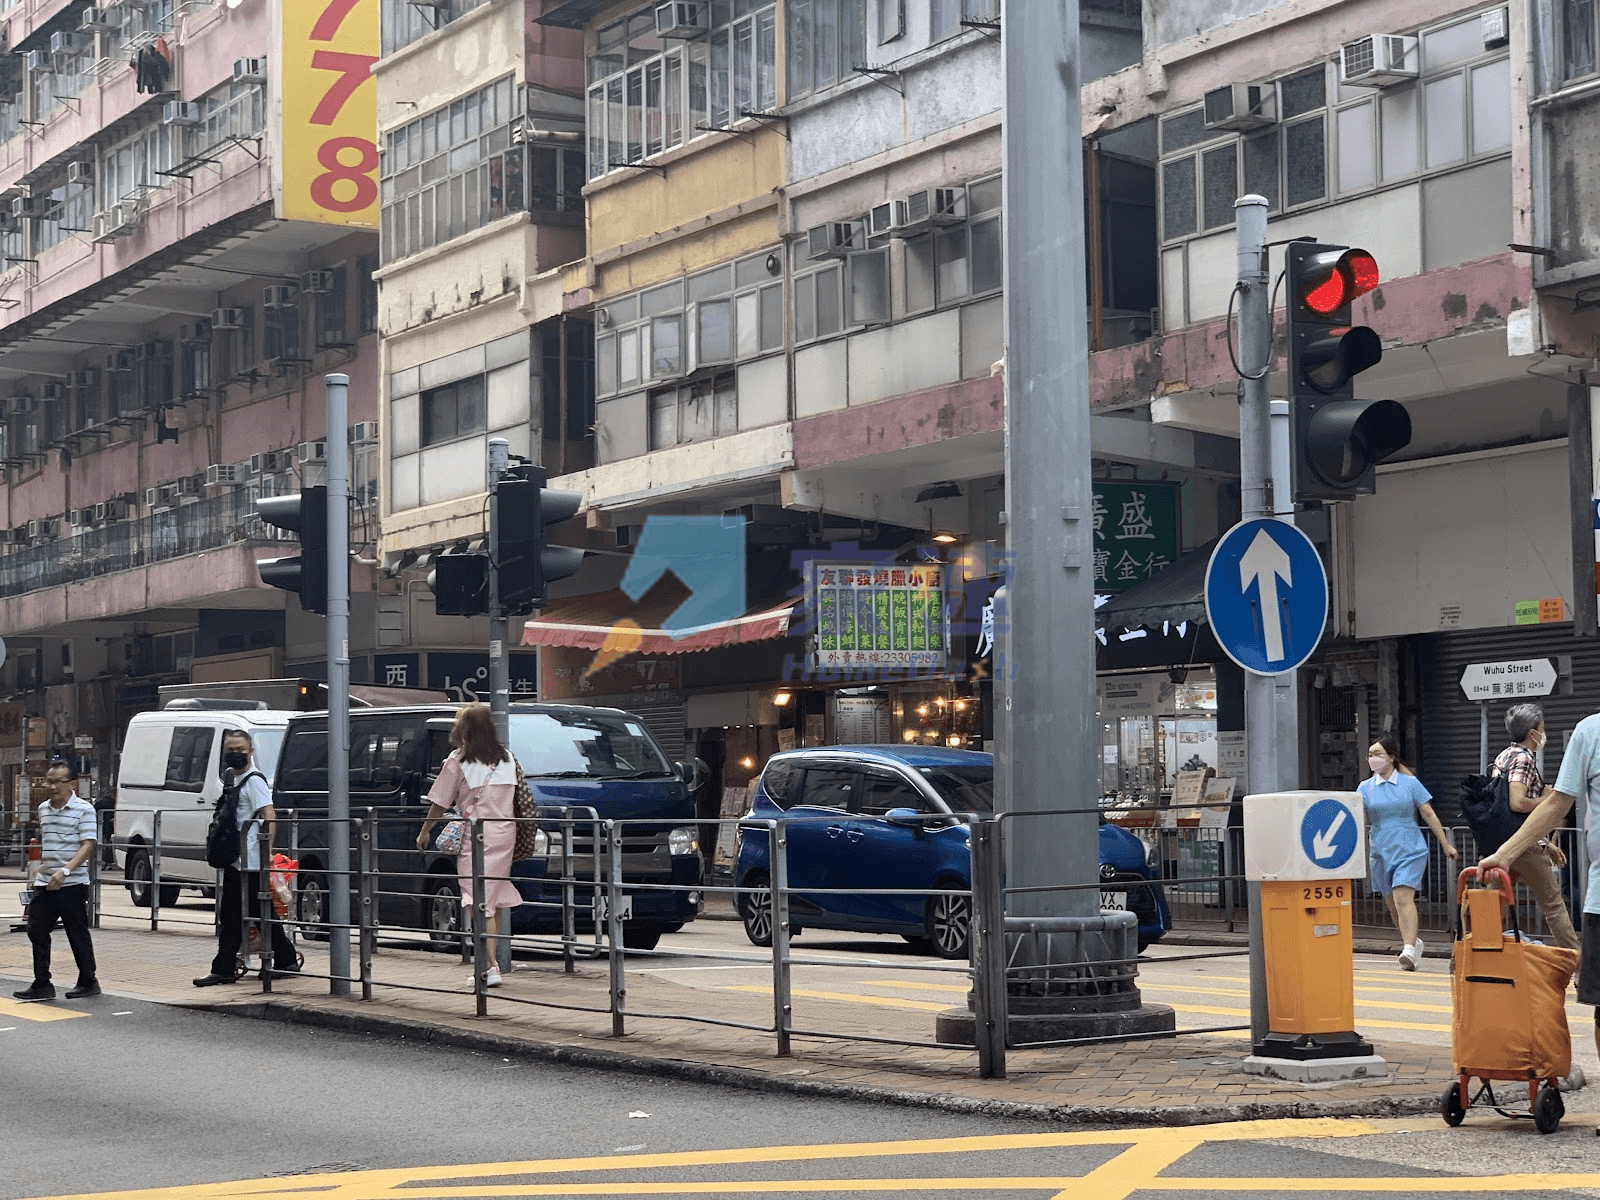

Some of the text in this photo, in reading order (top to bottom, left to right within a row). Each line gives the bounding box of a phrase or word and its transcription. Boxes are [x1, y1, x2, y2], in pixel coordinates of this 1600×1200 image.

[893, 591, 908, 648] 晚飯宵夜
[1483, 663, 1533, 675] Wuhu Street
[1491, 681, 1526, 696] 蕪湖街
[1303, 886, 1344, 900] 2556
